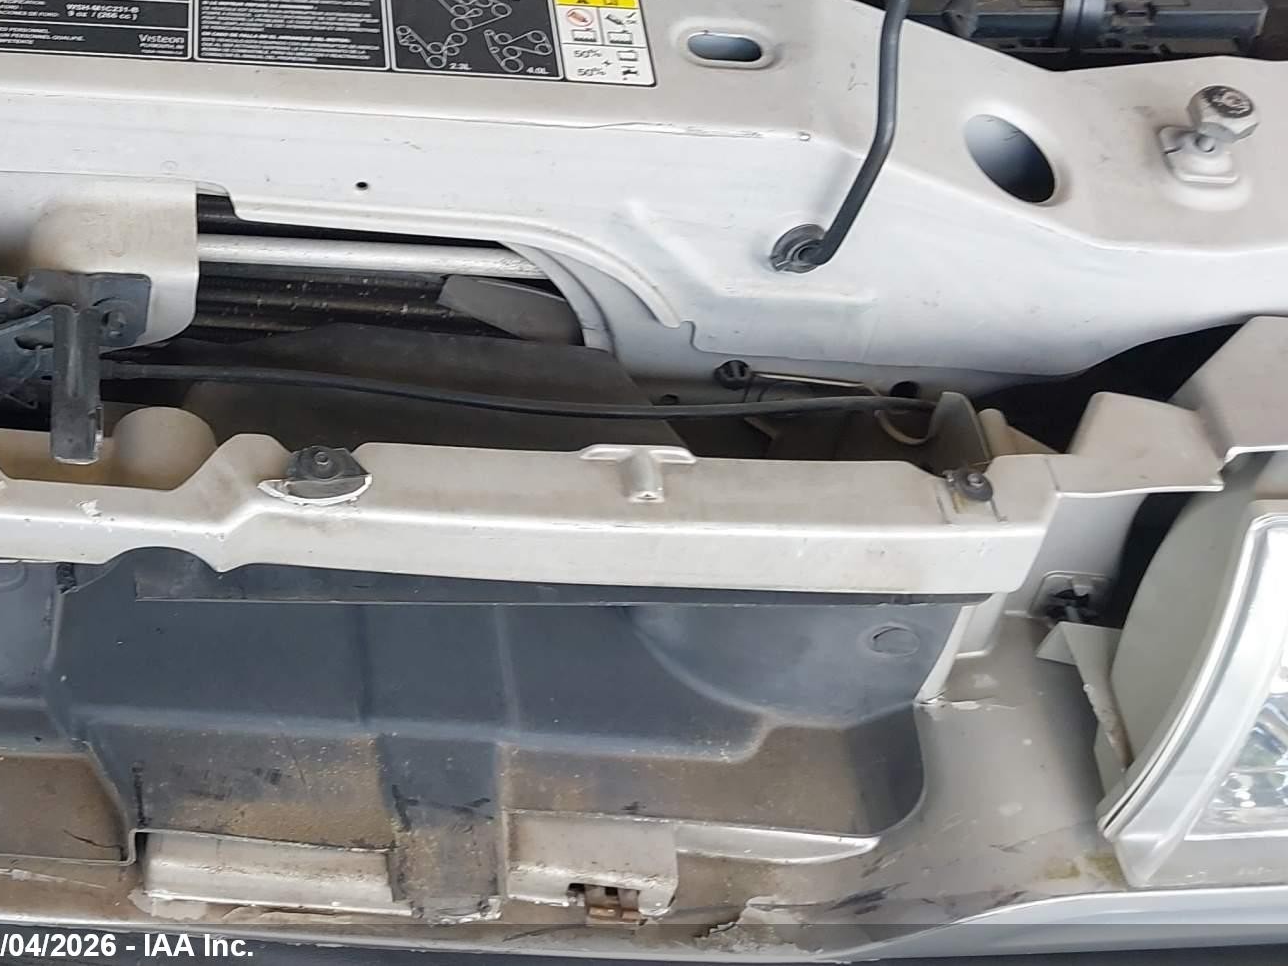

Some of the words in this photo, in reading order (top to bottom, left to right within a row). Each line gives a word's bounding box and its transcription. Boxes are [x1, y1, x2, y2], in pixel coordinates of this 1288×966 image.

[138, 34, 185, 44] Visteon
[574, 49, 602, 59] 50%
[577, 66, 607, 77] 50%
